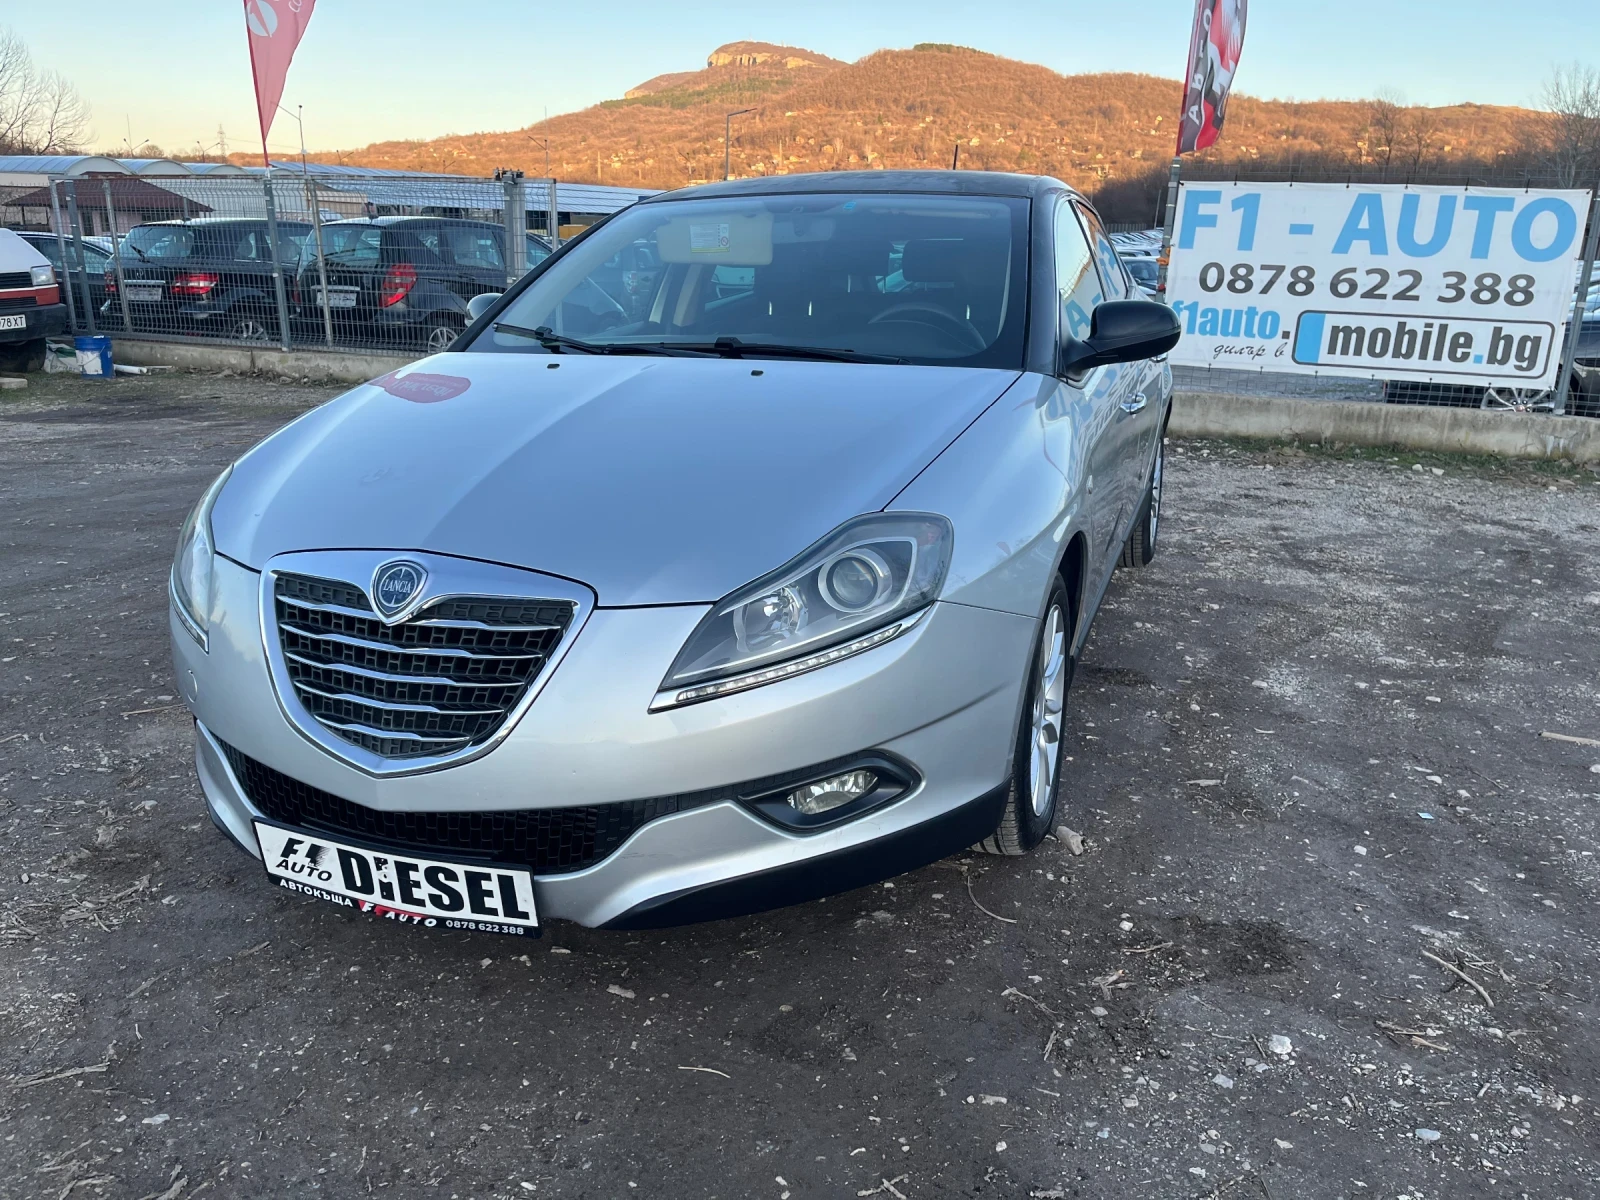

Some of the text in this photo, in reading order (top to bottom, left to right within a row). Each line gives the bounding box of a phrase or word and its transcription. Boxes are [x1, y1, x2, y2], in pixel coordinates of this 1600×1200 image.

[1178, 190, 1577, 263] F1 - AUTO
[1199, 261, 1536, 307] 0878 622 388
[1327, 321, 1542, 372] mobile.bg
[275, 858, 333, 882] AUTO
[279, 878, 354, 908] АВТОКЪЩА
[385, 911, 437, 927] AUTO
[445, 919, 476, 930] 0878
[478, 923, 500, 933] 622
[501, 925, 525, 935] 388
